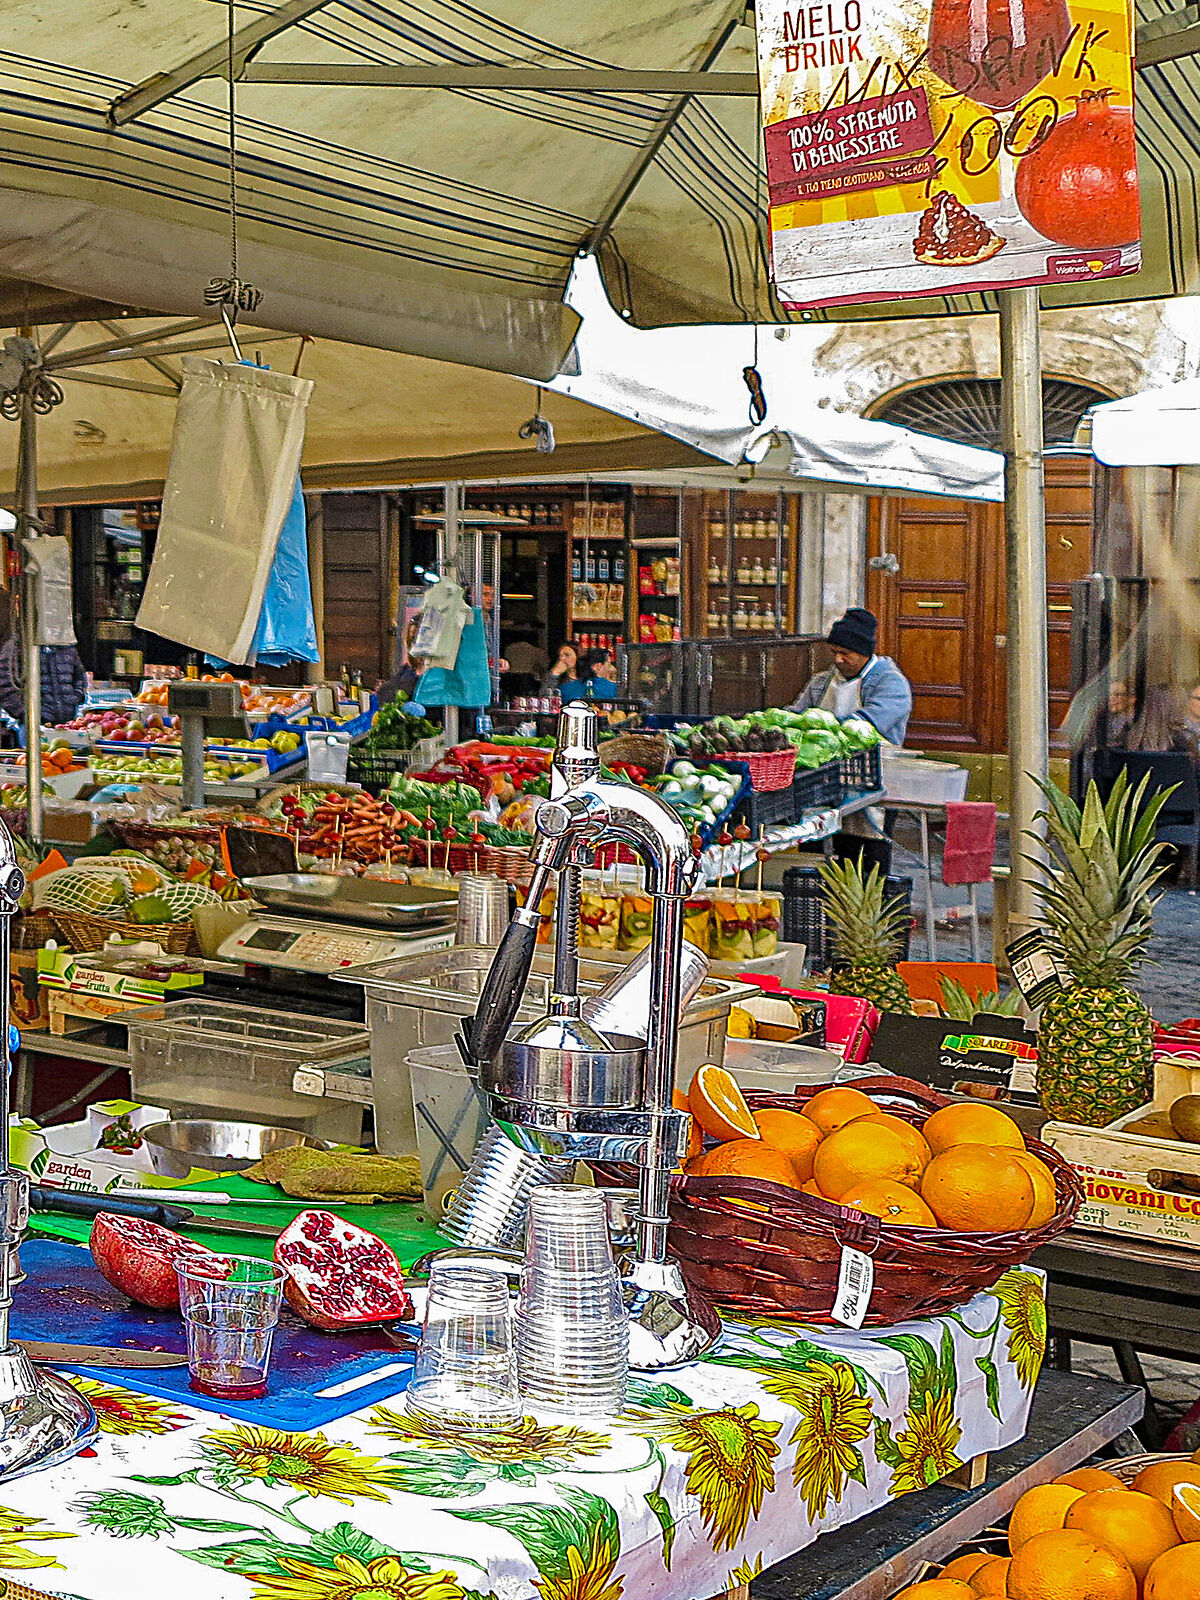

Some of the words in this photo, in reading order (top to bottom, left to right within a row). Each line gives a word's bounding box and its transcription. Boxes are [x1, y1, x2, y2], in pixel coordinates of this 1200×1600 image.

[783, 0, 862, 42] MELO
[784, 34, 864, 73] DRINK
[810, 47, 931, 127] MIX
[939, 22, 1110, 99] DRINK
[786, 118, 835, 149] 100%
[791, 150, 808, 172] DI
[807, 127, 904, 169] BENESSERE
[75, 970, 105, 982] garden
[86, 979, 111, 993] frutta
[46, 1161, 92, 1180] garden
[1080, 1174, 1166, 1210] iovani
